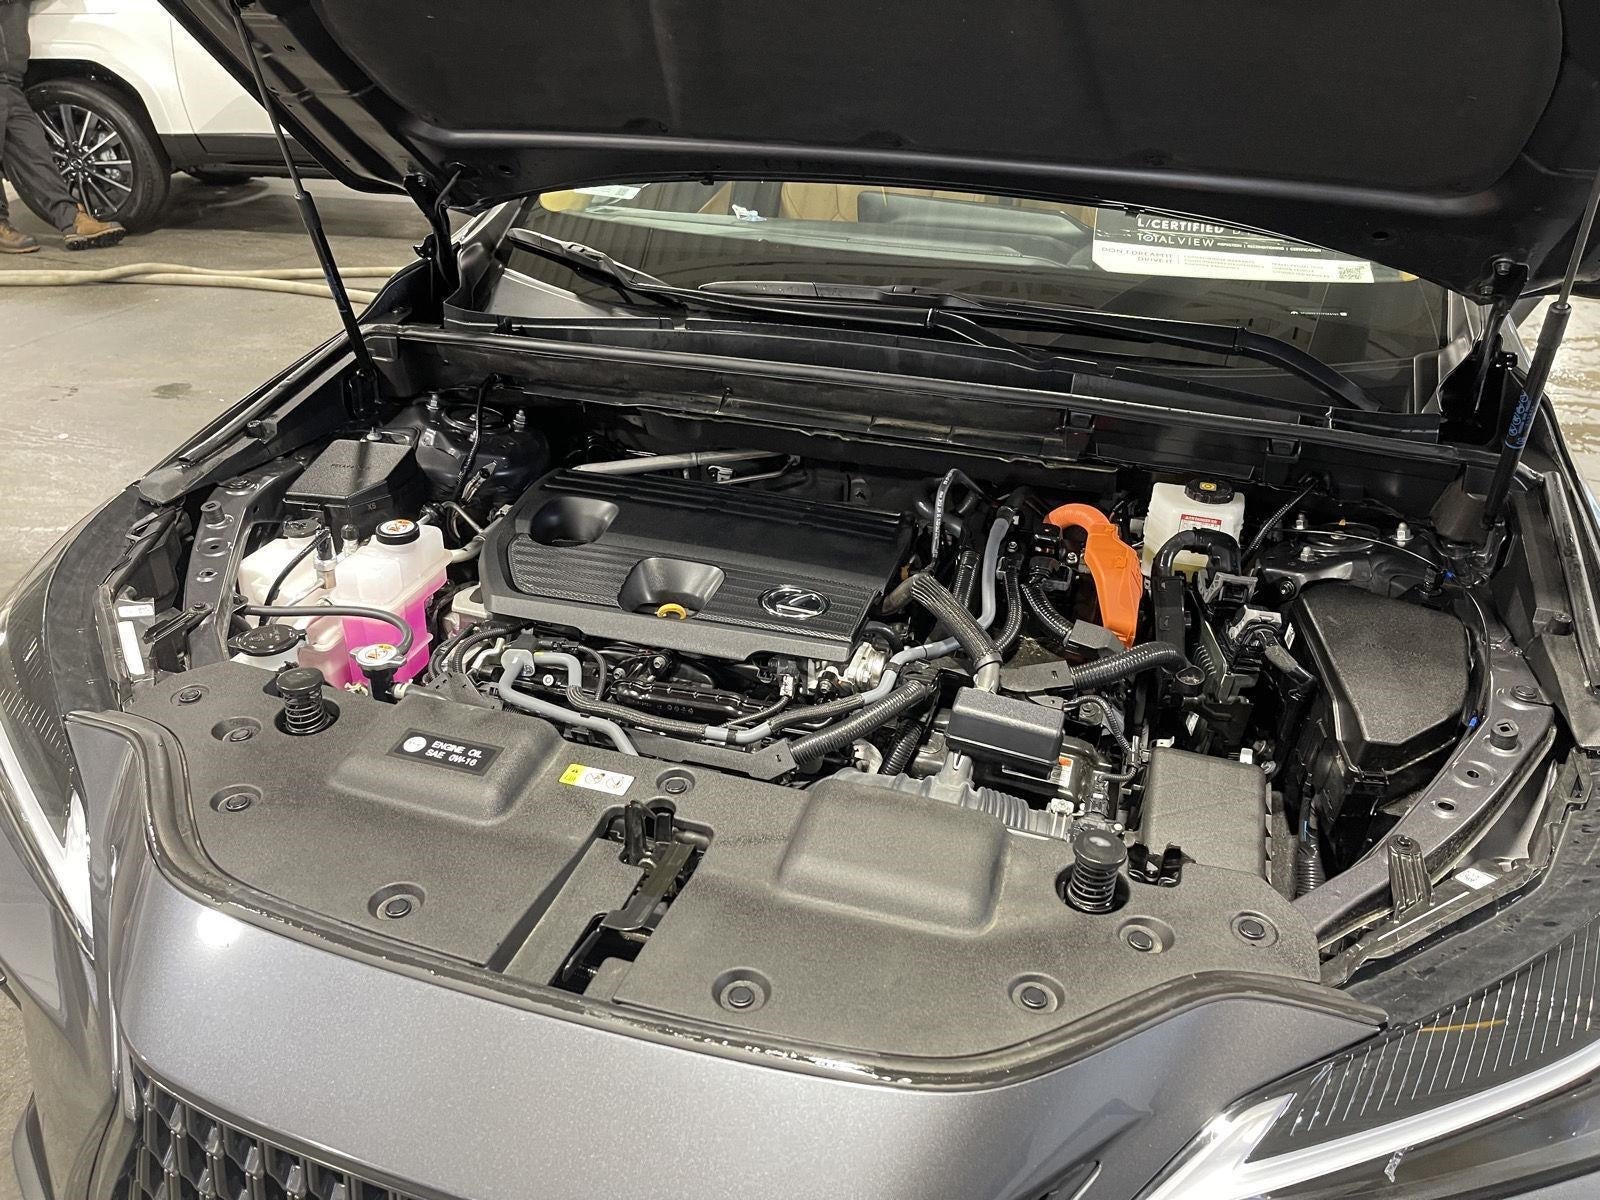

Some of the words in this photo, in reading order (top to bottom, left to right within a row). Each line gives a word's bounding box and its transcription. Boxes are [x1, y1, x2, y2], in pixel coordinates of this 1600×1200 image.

[1137, 217, 1224, 234] L/CERTIFIED
[1137, 233, 1175, 245] TOTAL
[1177, 236, 1214, 247] VIEW
[425, 748, 446, 759] SAE
[431, 740, 466, 753] ENGINE
[467, 749, 483, 759] OIL
